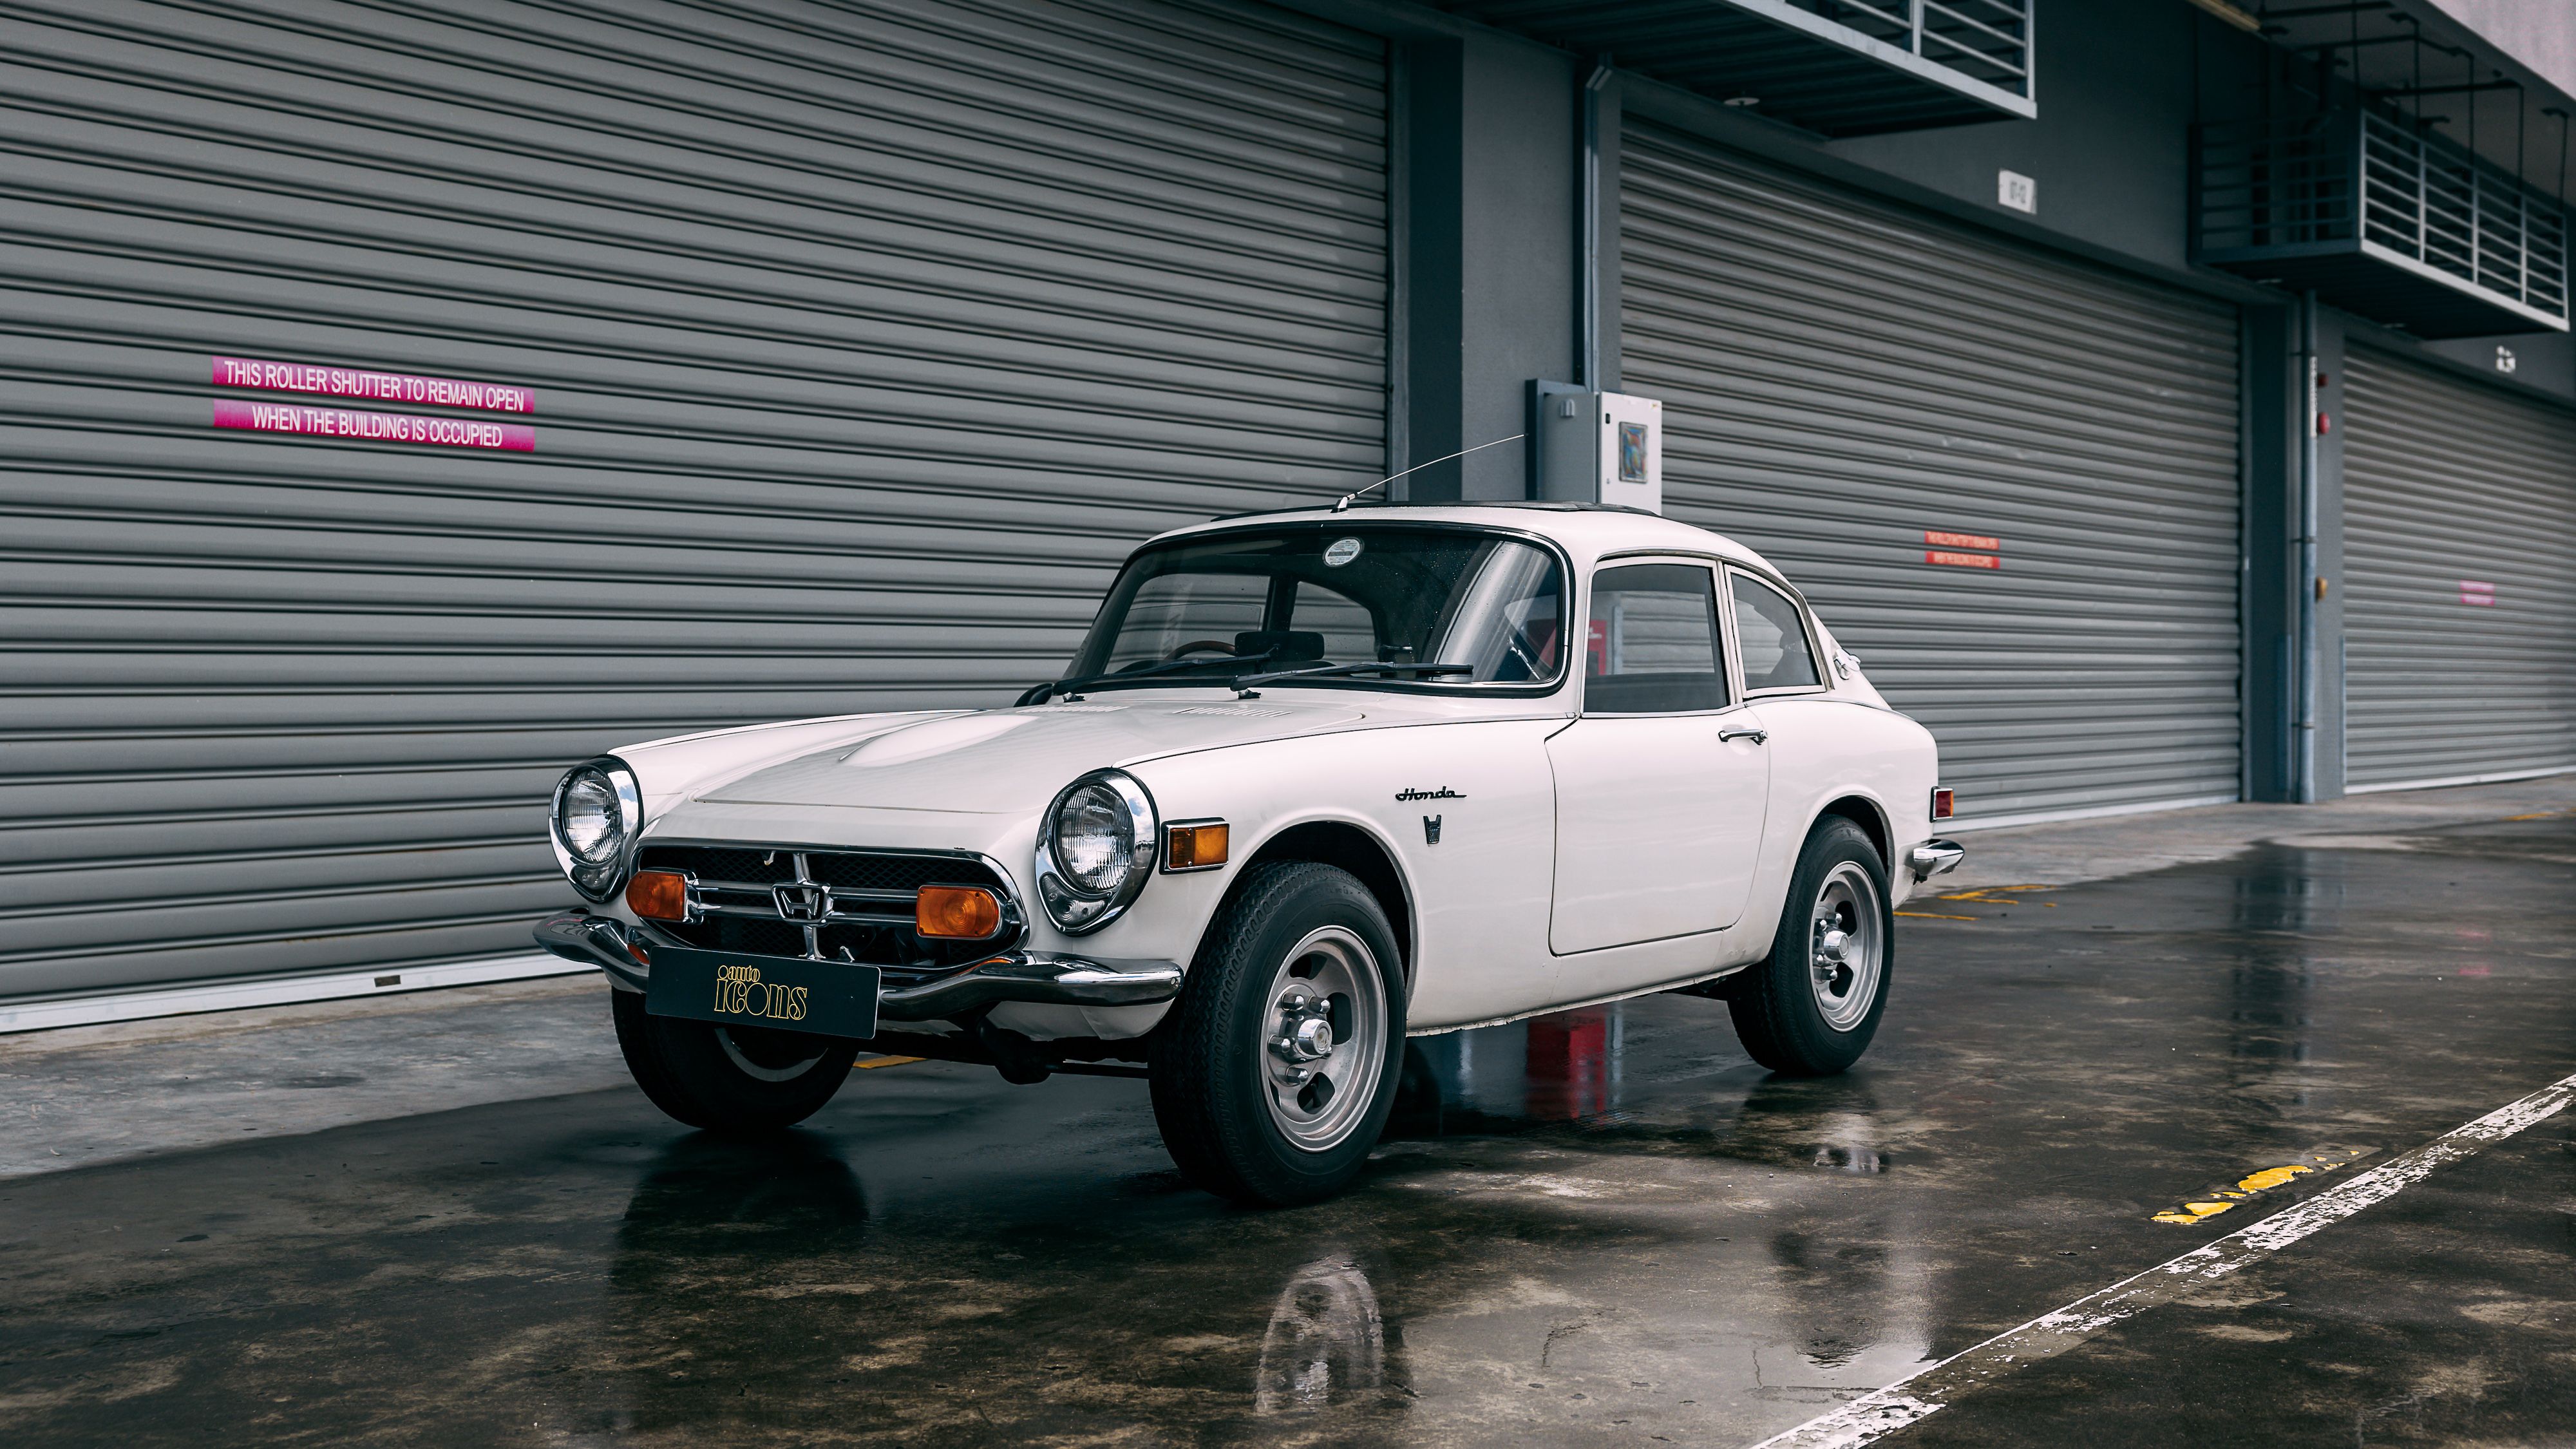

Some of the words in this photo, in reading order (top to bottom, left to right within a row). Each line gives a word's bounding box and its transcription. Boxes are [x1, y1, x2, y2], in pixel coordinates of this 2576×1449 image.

[224, 360, 261, 386] THIS
[265, 364, 327, 392] ROLLER
[331, 370, 401, 398] SHUTTER
[404, 377, 425, 401] TO
[428, 381, 482, 407] REMAIN
[486, 387, 524, 412] OPEN
[252, 405, 301, 431] WHEN
[303, 409, 335, 434] THE
[338, 412, 408, 440] BUILDING
[412, 419, 426, 441] IS
[429, 420, 503, 447] OCCUPIED
[1395, 786, 1467, 802] Honda
[714, 965, 808, 1021] icons
[728, 965, 761, 983] auto
